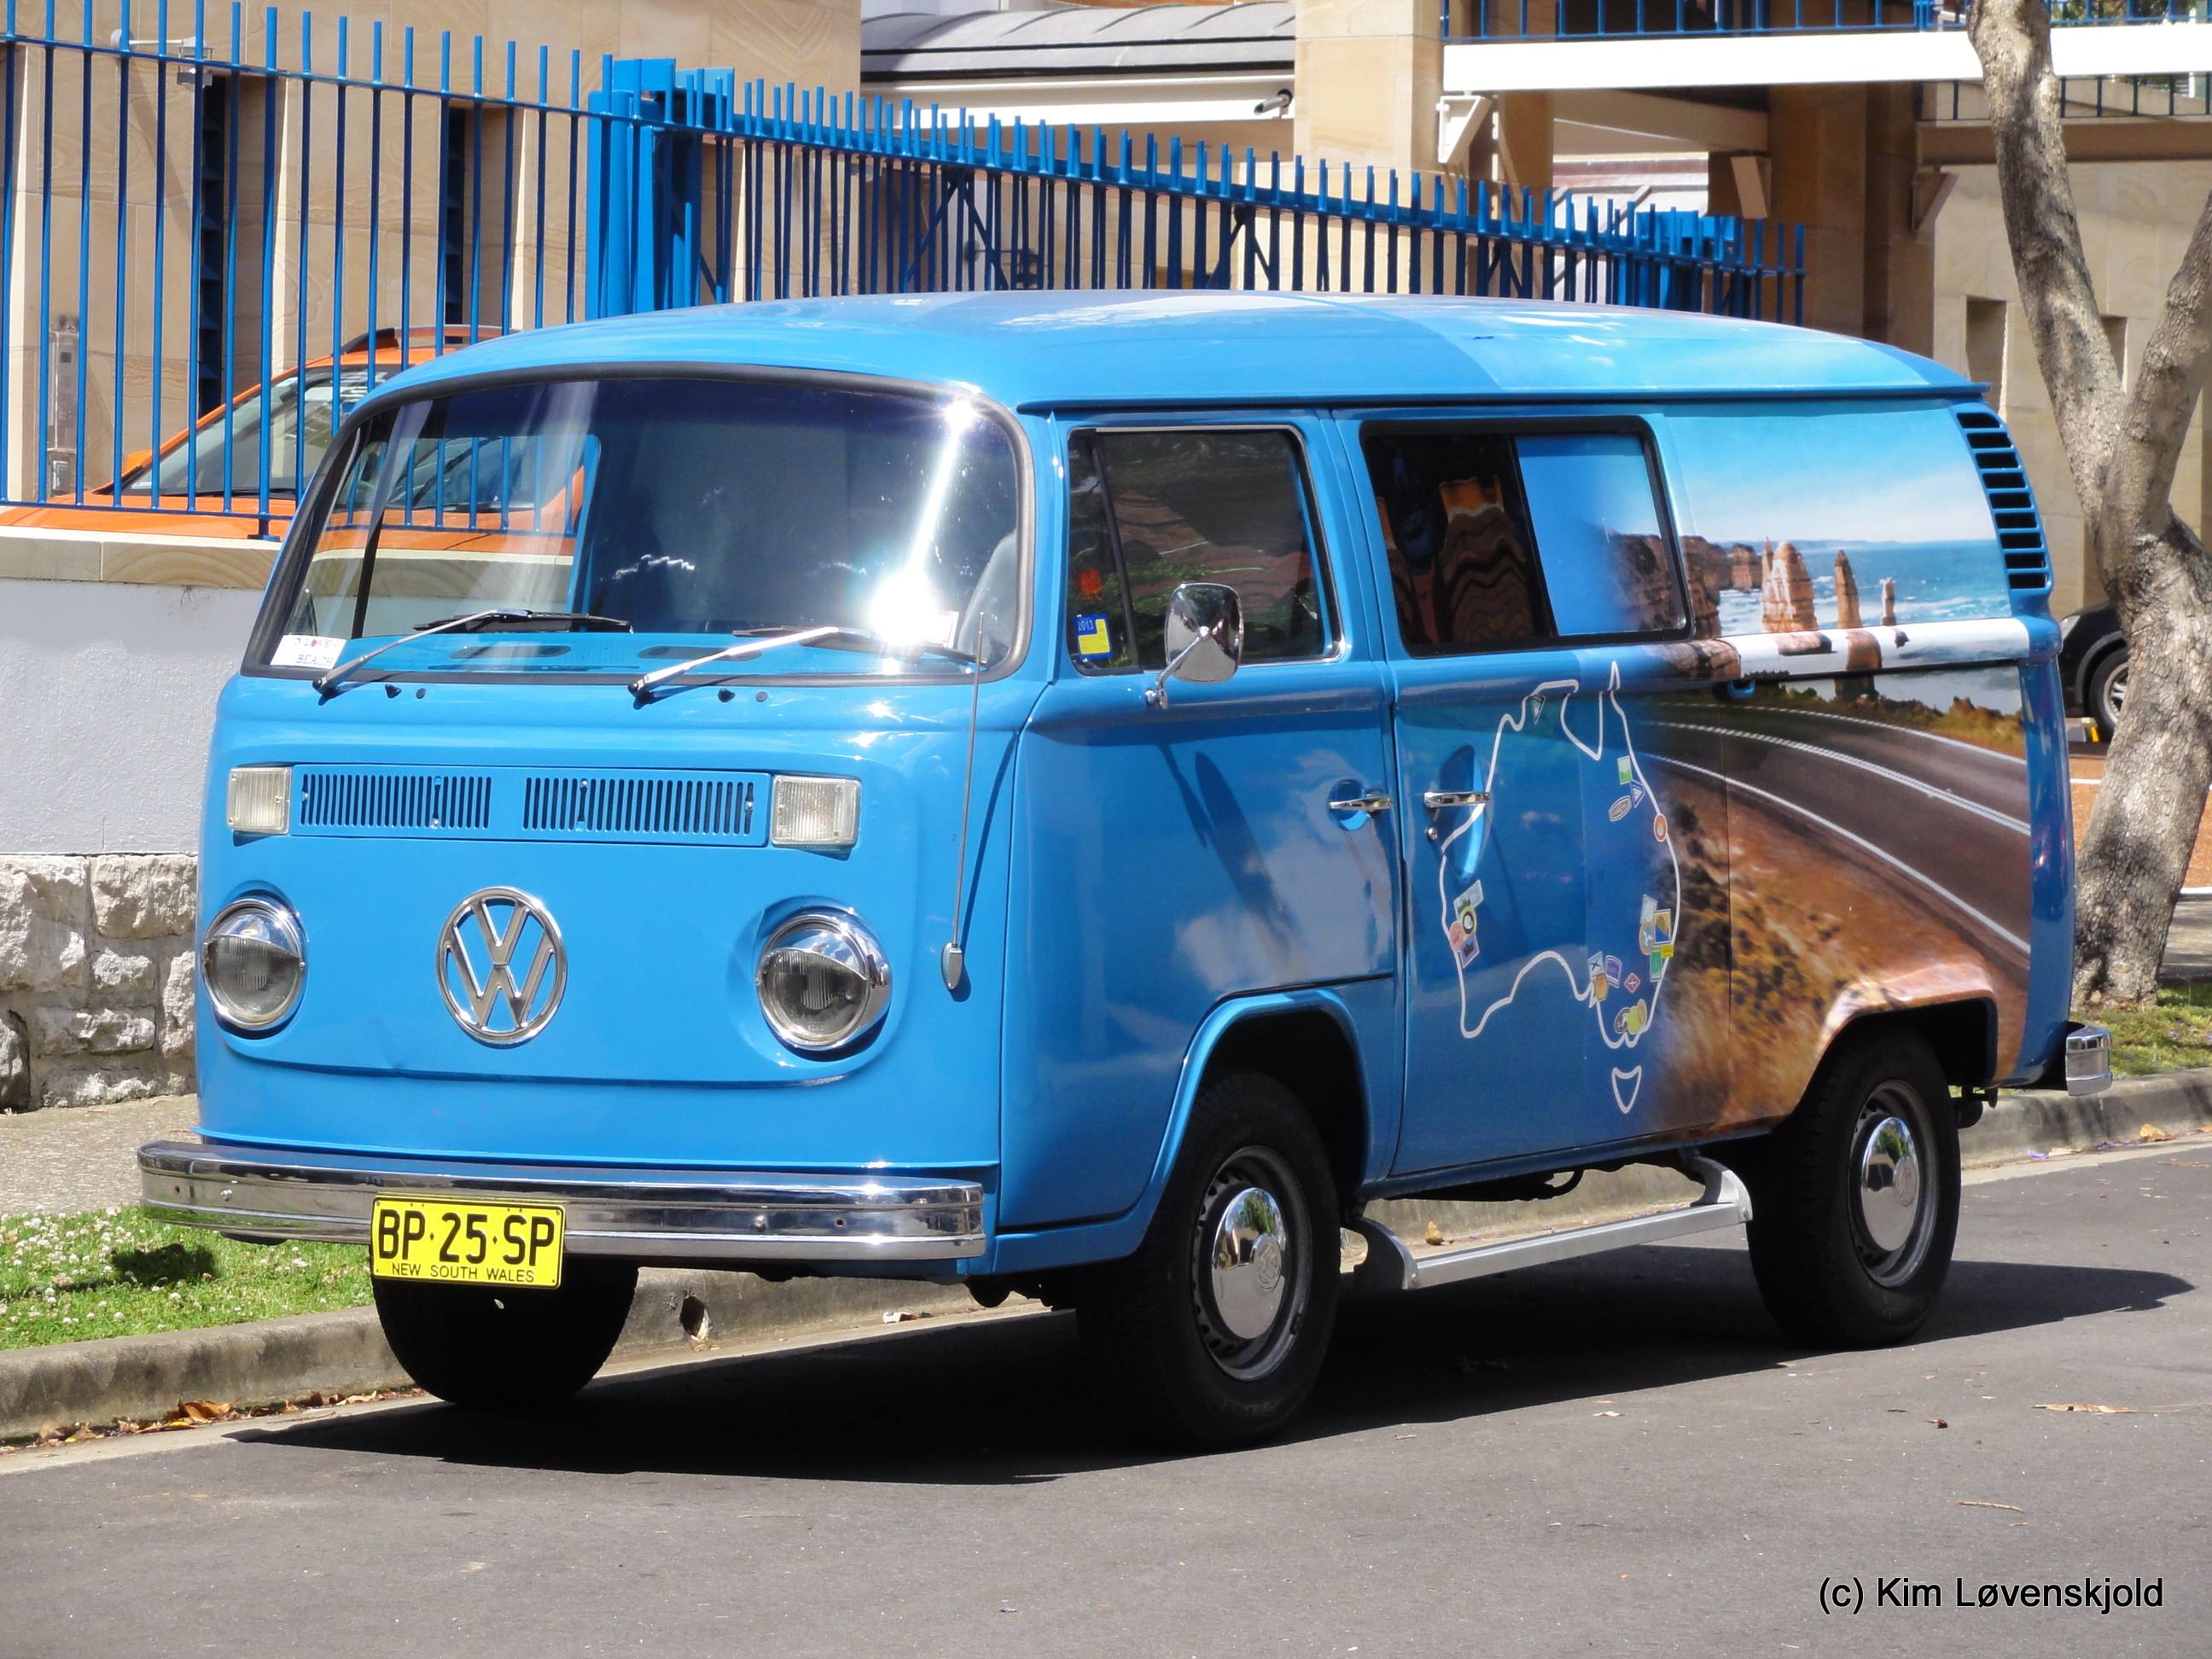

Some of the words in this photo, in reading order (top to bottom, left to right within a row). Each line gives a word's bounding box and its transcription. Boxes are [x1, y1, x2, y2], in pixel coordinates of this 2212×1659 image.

[297, 655, 335, 666] BEACH
[392, 1262, 422, 1277] NEW
[430, 1266, 478, 1280] SOUTH
[486, 1267, 535, 1283] WALES
